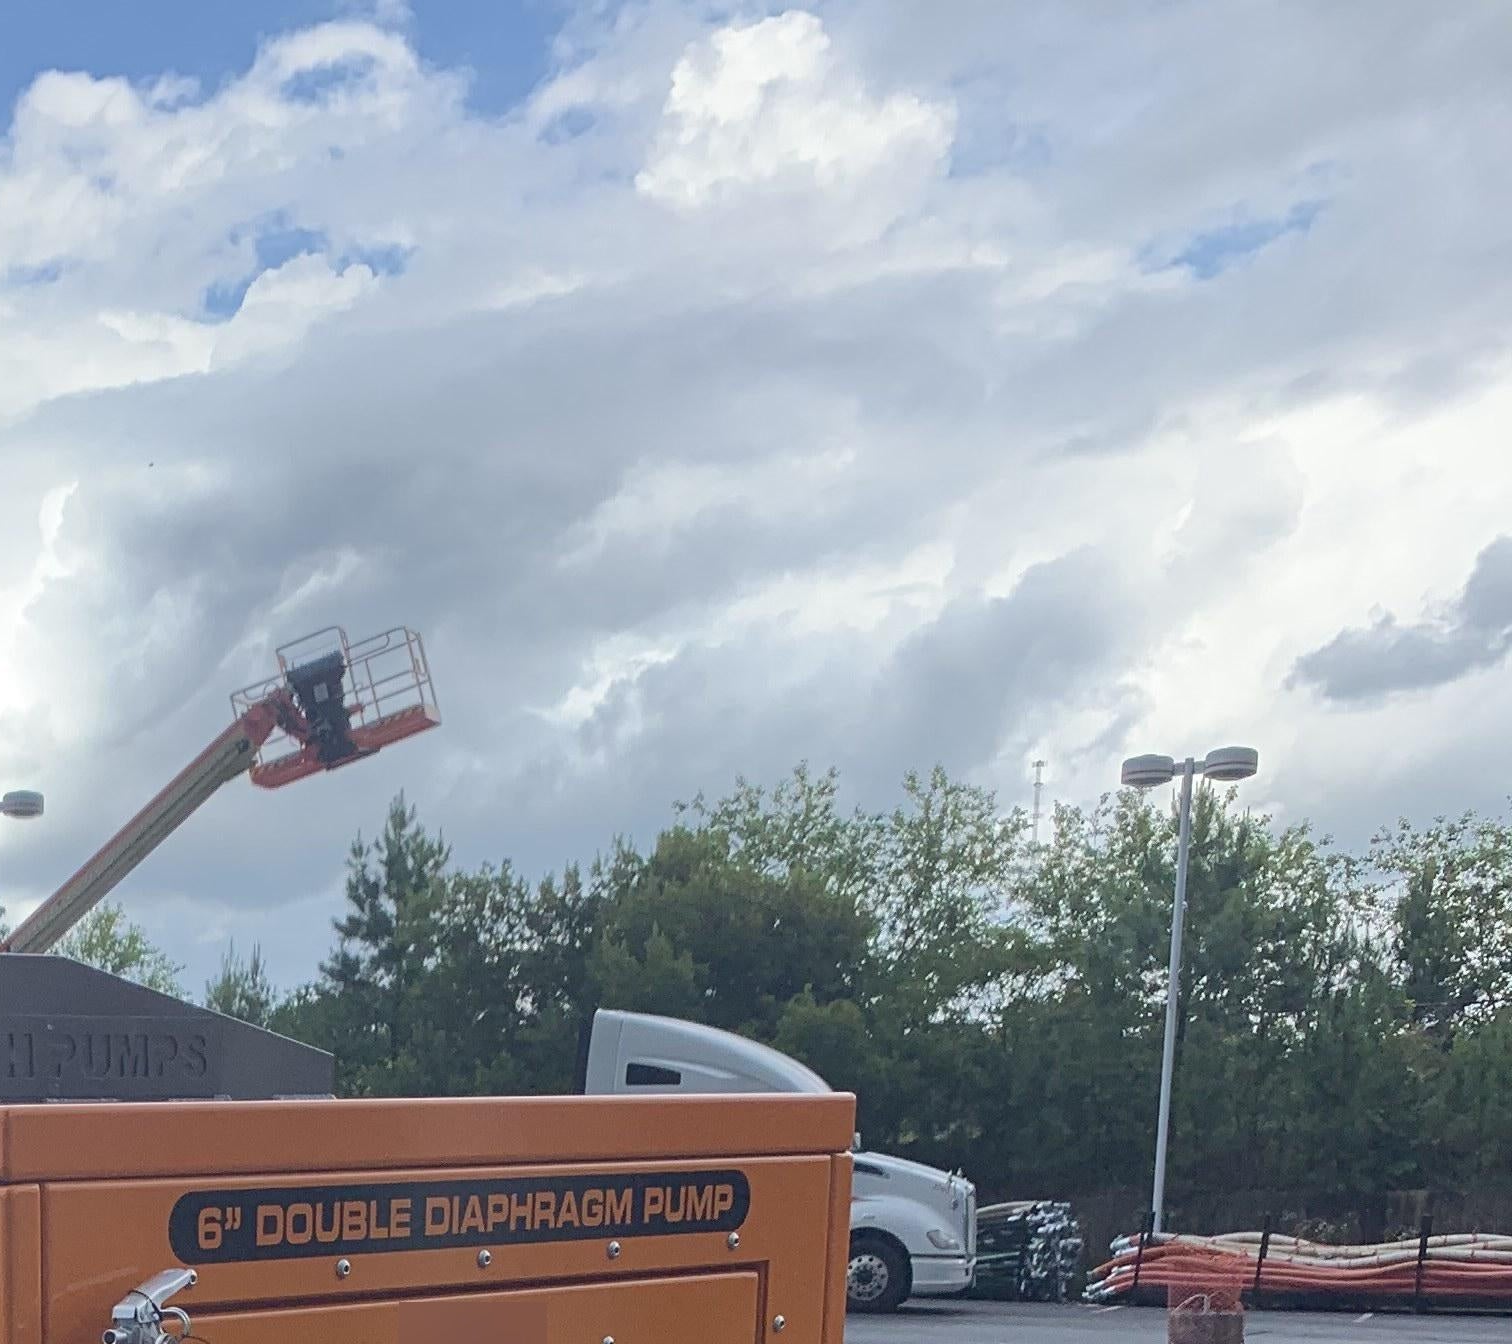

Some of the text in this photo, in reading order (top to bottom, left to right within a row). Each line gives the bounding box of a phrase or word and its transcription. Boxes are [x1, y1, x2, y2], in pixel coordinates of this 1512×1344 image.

[44, 1031, 208, 1080] PUMPS
[255, 1198, 412, 1247] DOUBLE
[424, 1187, 633, 1237] DIAPHRAGM
[643, 1183, 734, 1224] PUMP
